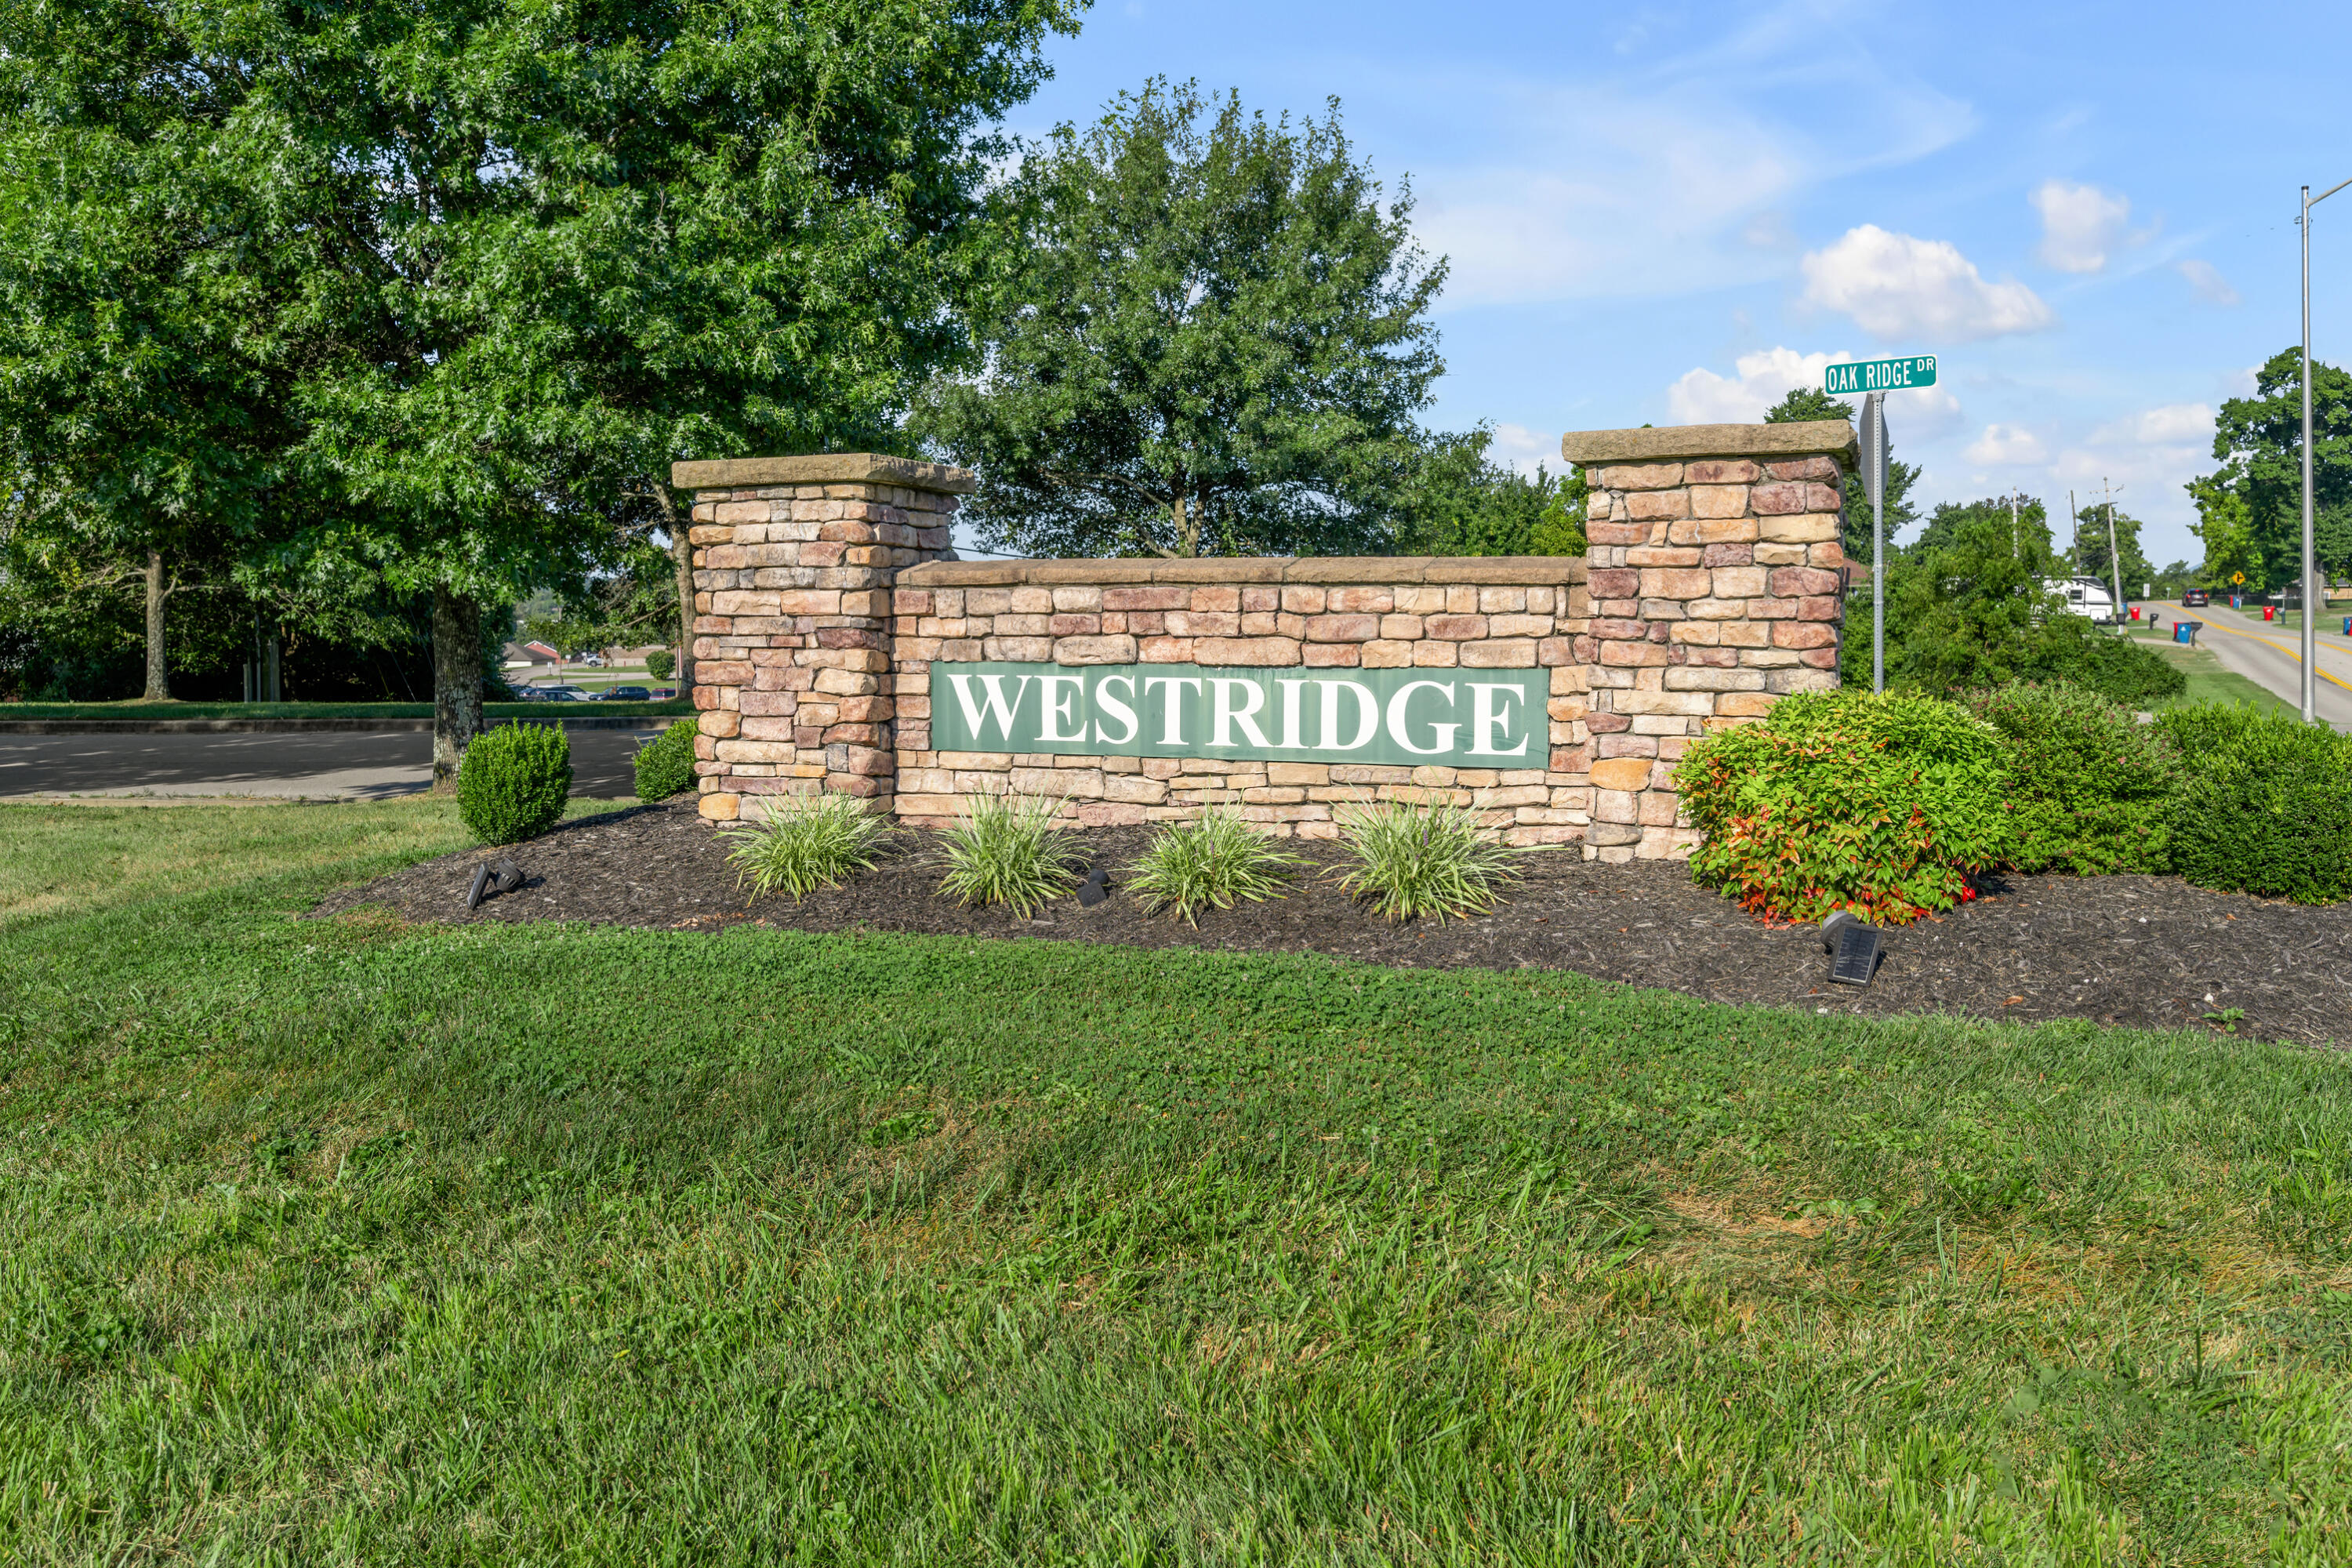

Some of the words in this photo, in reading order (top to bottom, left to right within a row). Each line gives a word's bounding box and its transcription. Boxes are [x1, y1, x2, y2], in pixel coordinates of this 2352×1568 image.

[1828, 366, 1858, 391] OAK
[1866, 361, 1912, 388] RIDGE
[1917, 358, 1934, 372] DR
[947, 674, 1530, 757] WESTRIDGE
